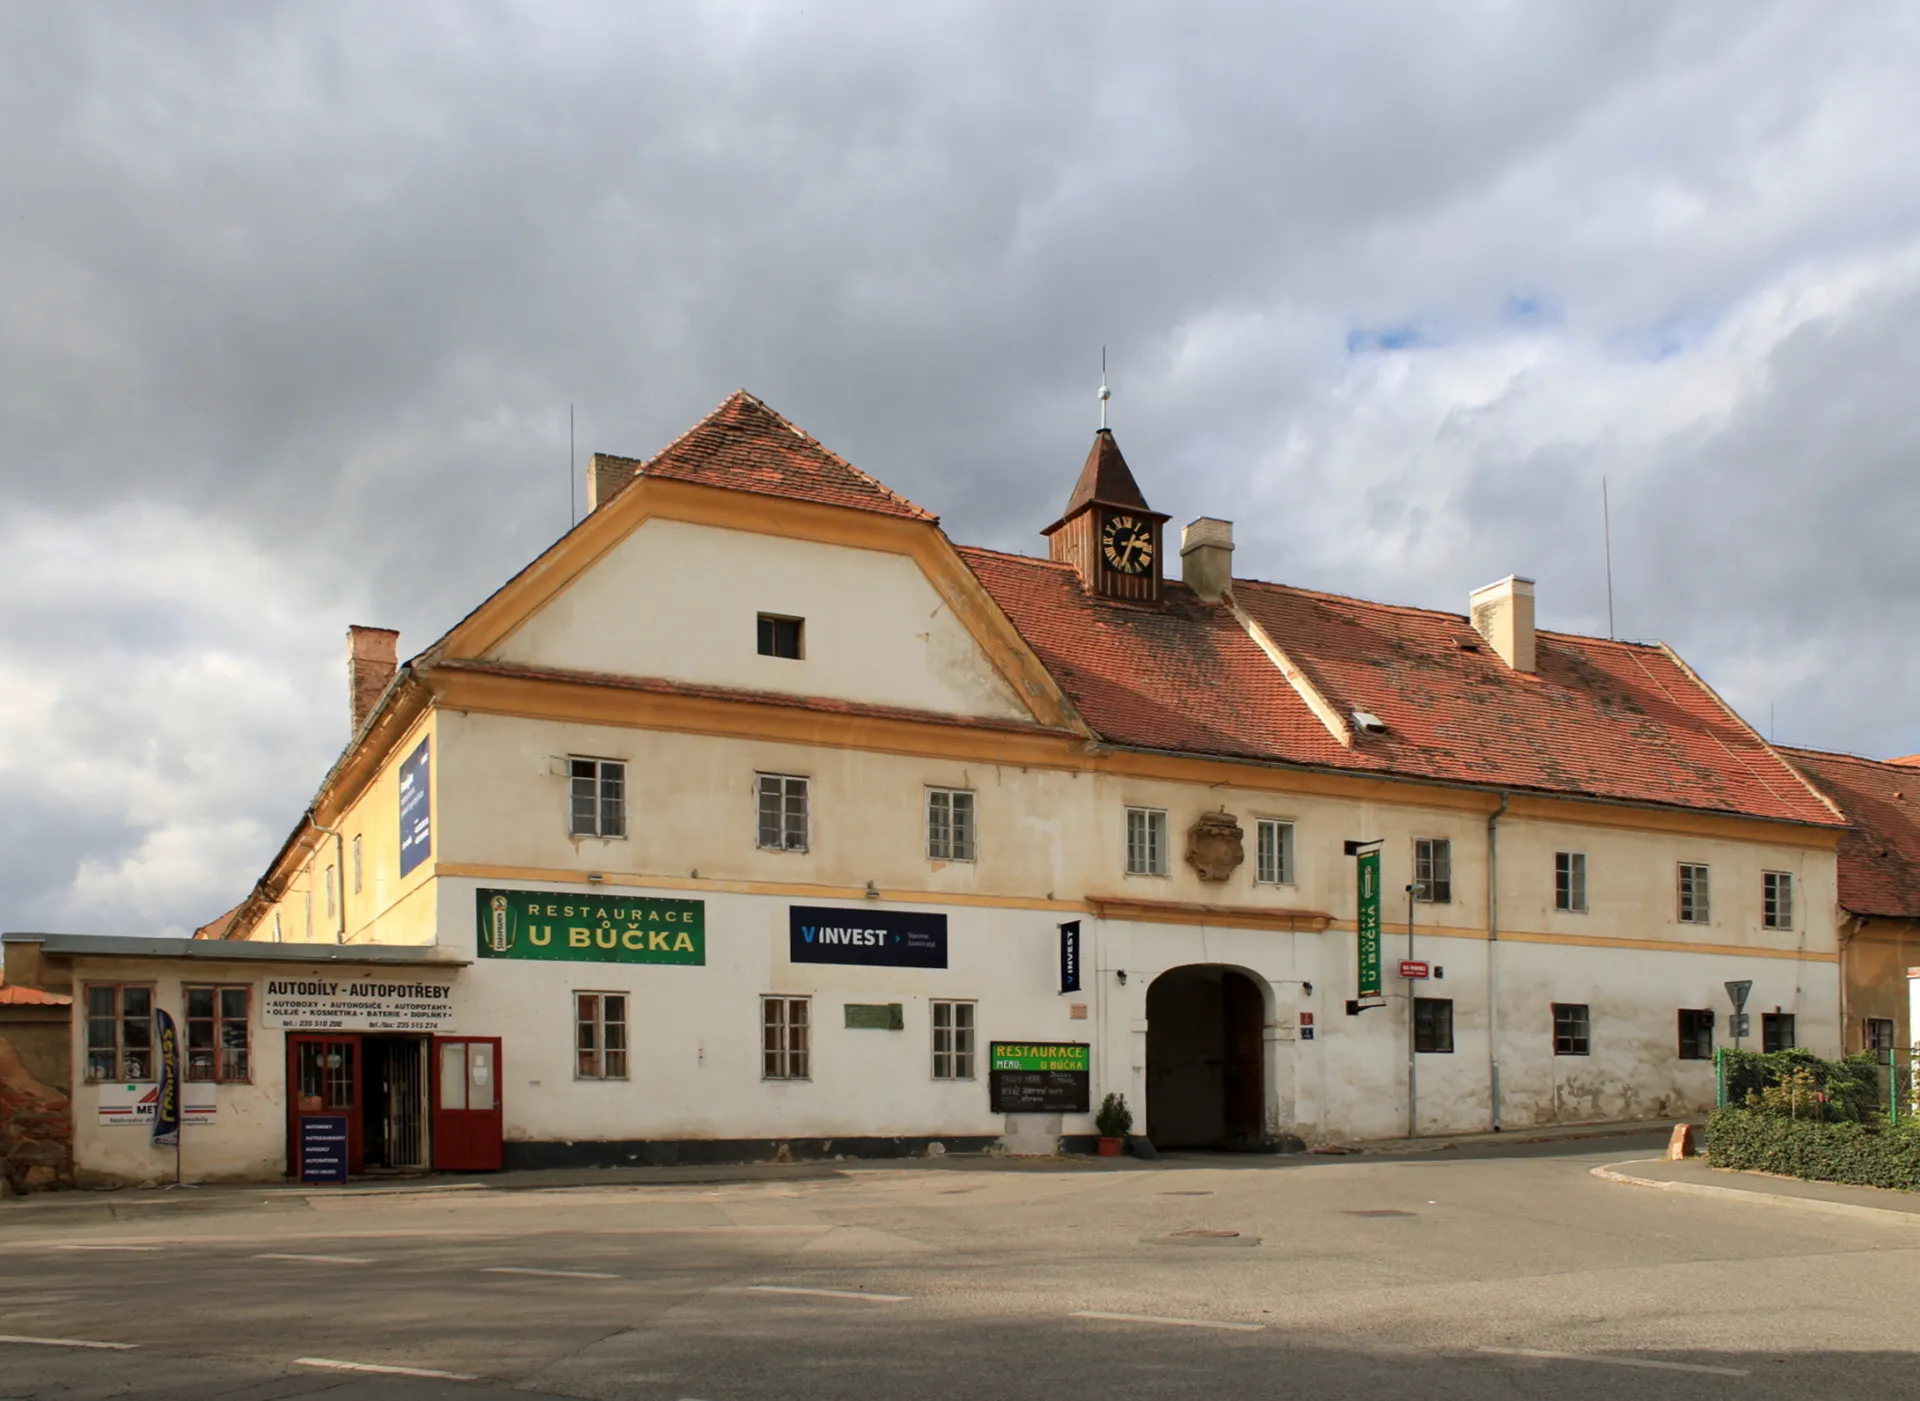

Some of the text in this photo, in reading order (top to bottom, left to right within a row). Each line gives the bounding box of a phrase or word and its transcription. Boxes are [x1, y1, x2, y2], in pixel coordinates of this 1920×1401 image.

[528, 904, 694, 923] RESTAURACE
[528, 920, 696, 952] U BŮČKA
[1368, 970, 1377, 982] U
[267, 979, 338, 996] AUTODÍLY
[350, 982, 450, 999] AUTOPOTŘEBY
[330, 1001, 382, 1009] AUTONOSIČE
[996, 1045, 1083, 1058] RESTAURACE
[1040, 1061, 1047, 1070] U
